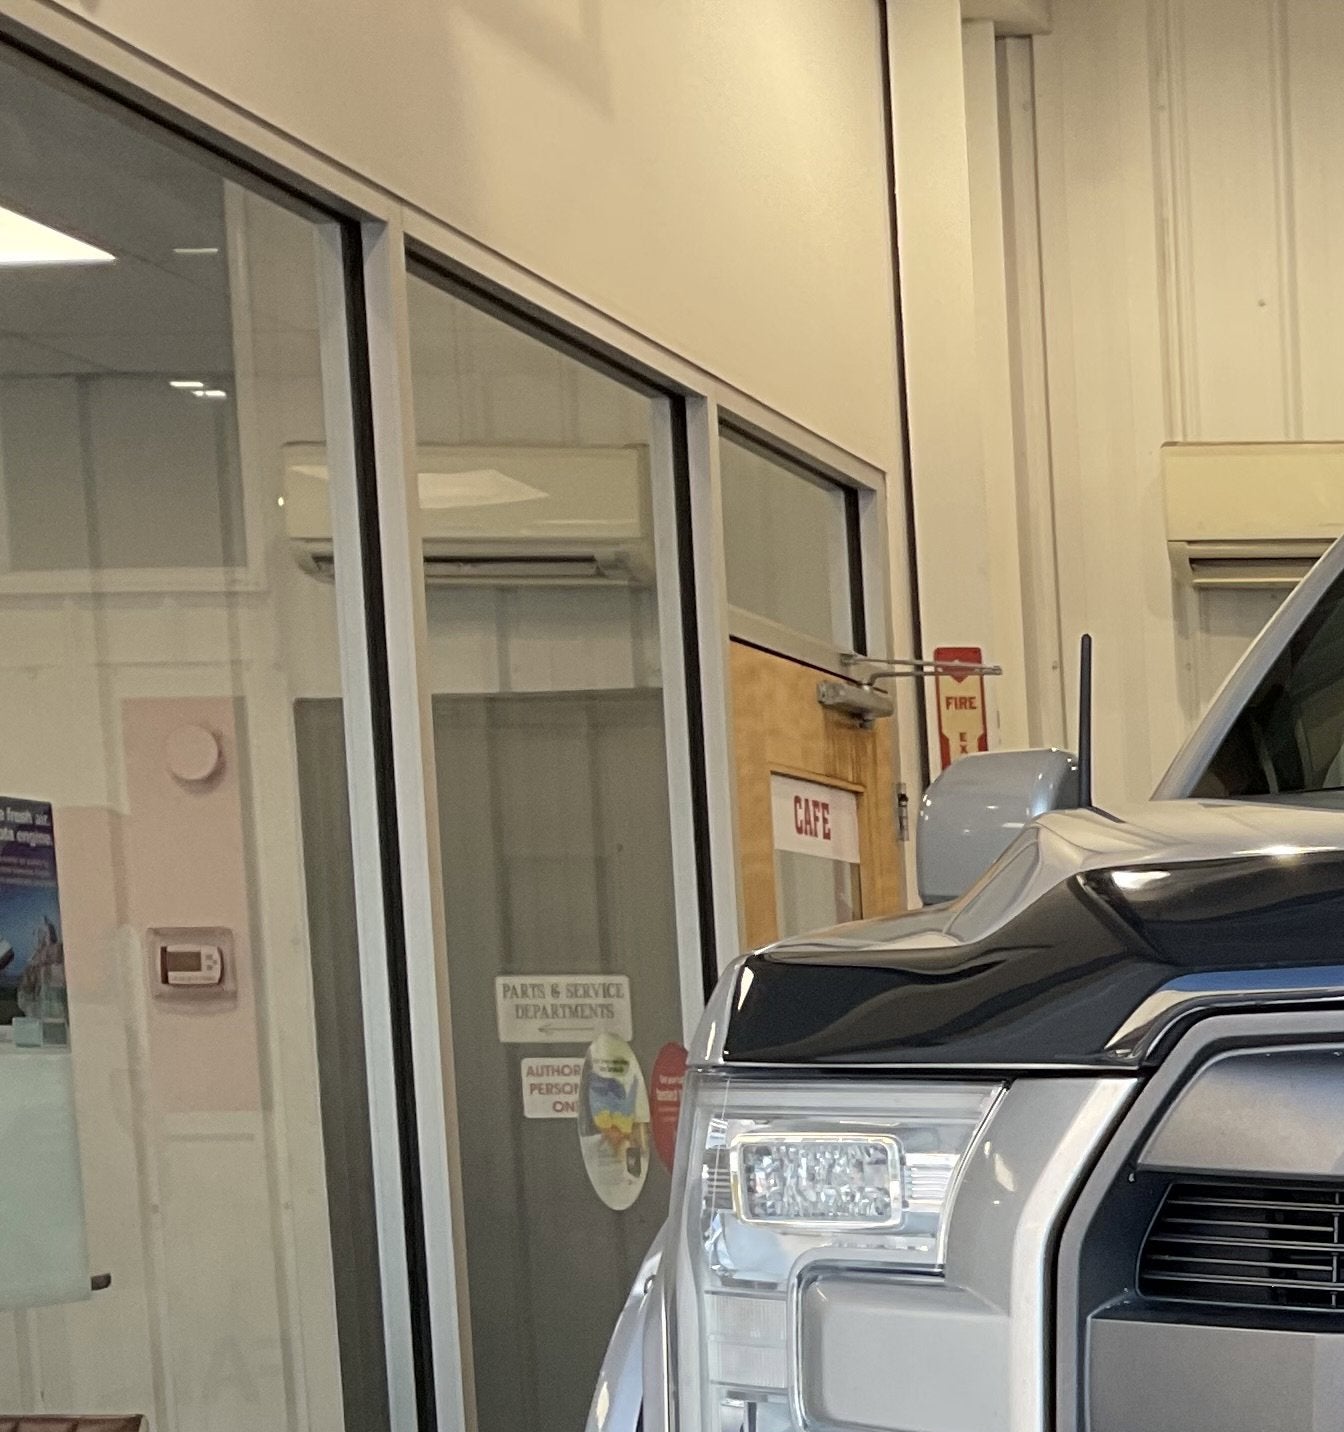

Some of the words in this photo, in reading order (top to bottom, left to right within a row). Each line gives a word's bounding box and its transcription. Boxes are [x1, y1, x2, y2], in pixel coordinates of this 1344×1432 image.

[945, 696, 977, 710] FIRE
[794, 795, 831, 840] CAFE
[502, 983, 546, 999] PARTS
[551, 983, 561, 999] &
[566, 983, 625, 999] SERVICE
[515, 1004, 615, 1019] DEPARTMENTS
